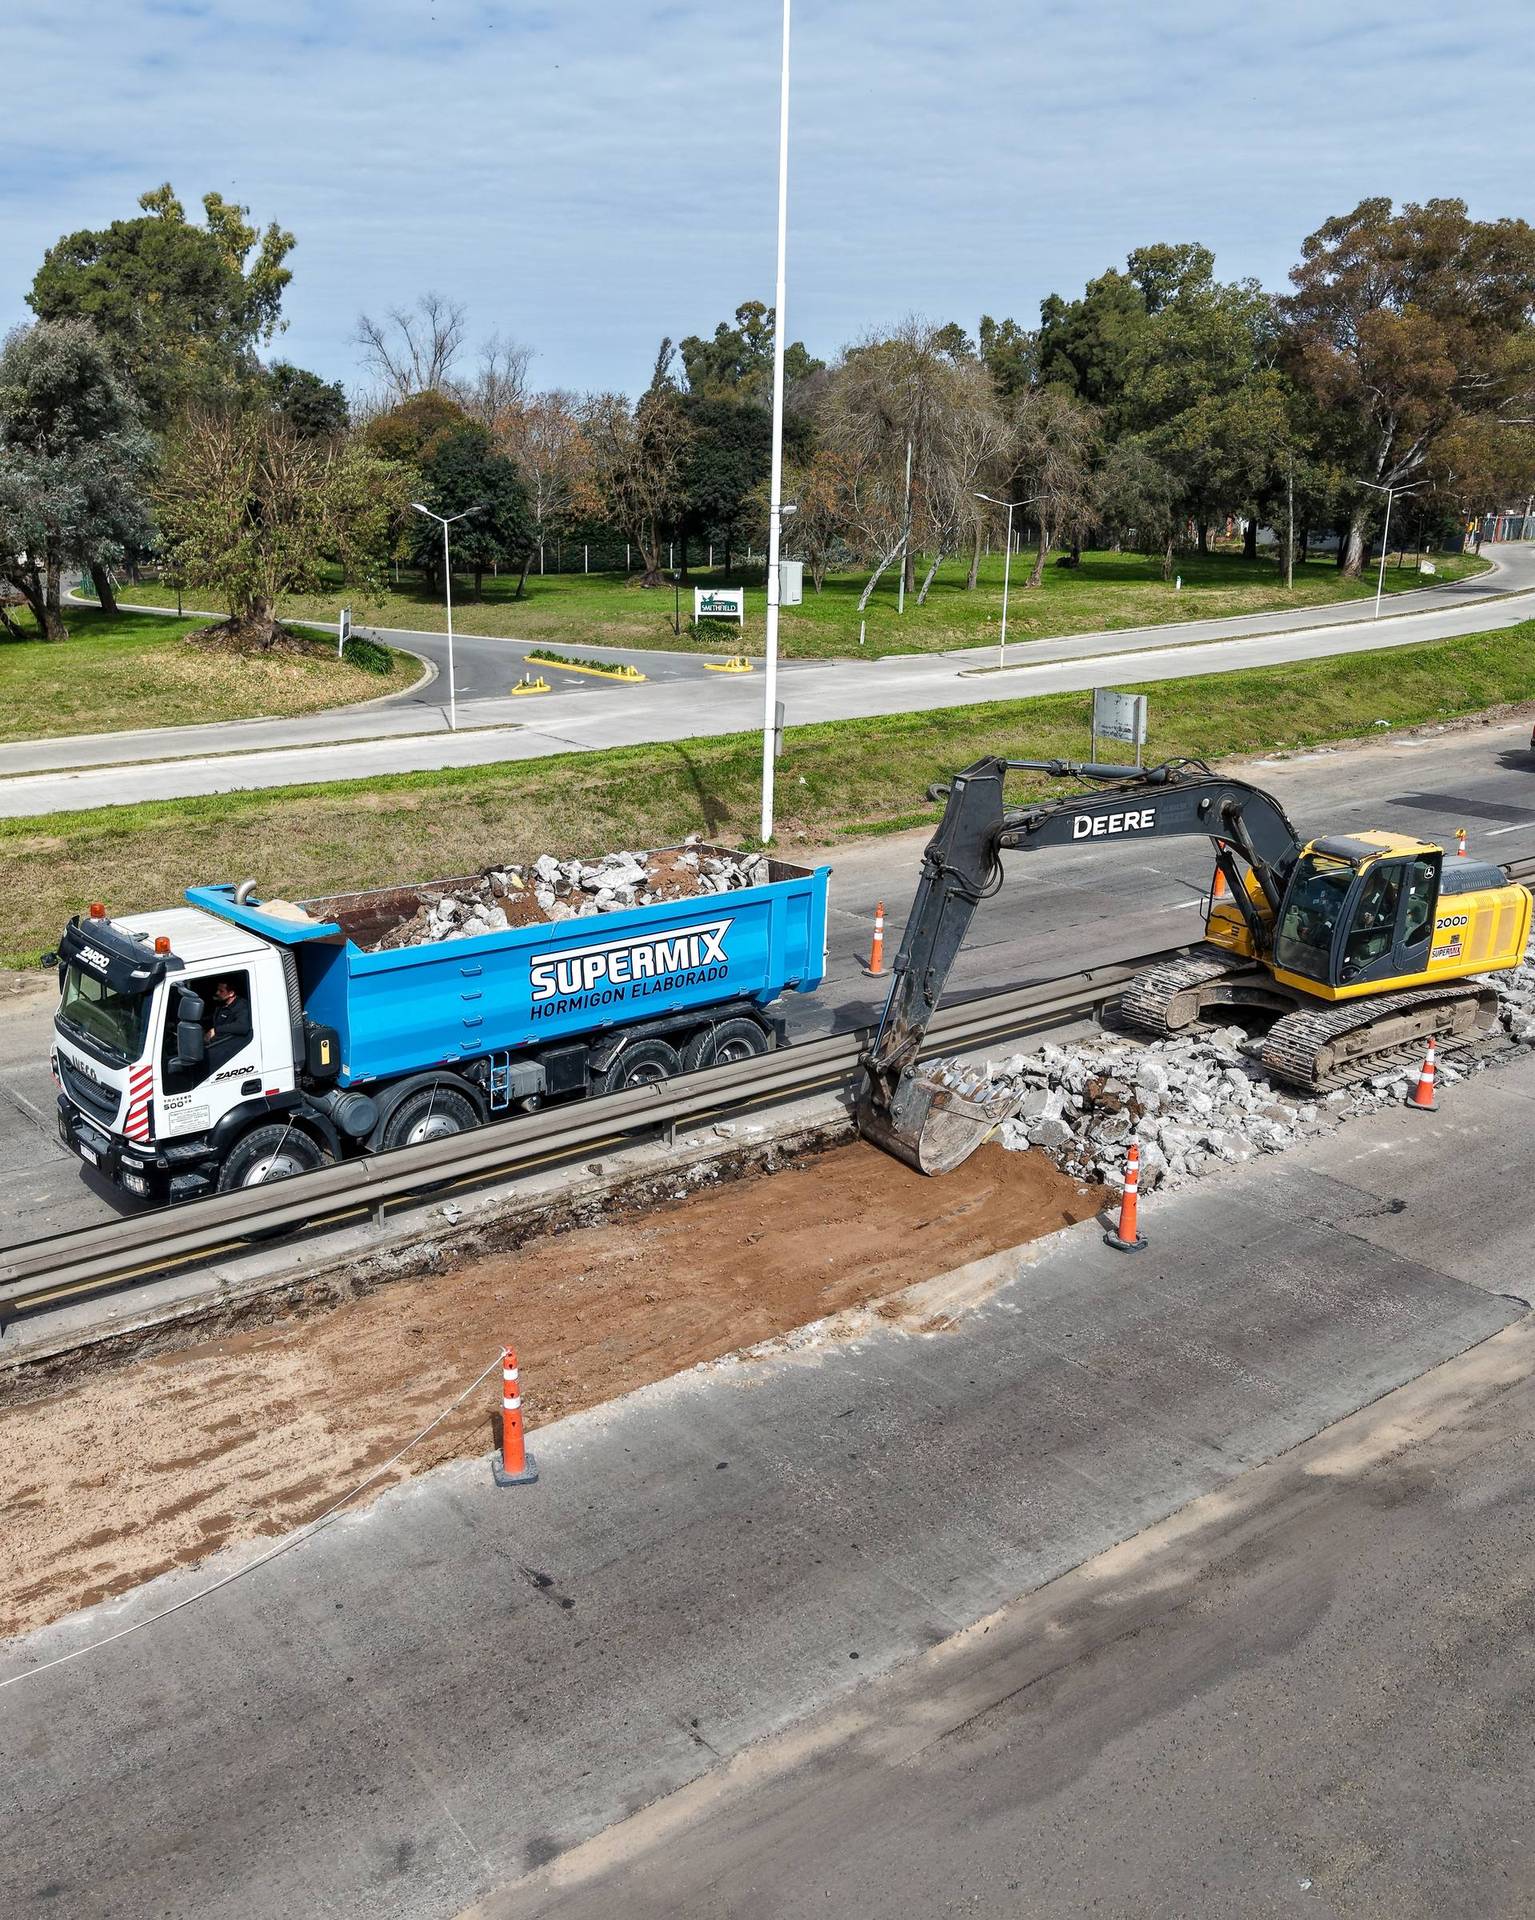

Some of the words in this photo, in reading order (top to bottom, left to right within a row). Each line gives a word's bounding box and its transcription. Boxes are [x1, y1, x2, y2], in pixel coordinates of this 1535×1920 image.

[1073, 808, 1156, 839] DEERE
[1436, 916, 1467, 929] 200D
[80, 945, 110, 968] ZARDO
[530, 917, 736, 1001] SUPERMIX
[530, 987, 624, 1020] HORMIGON
[631, 965, 728, 998] ELABORADO
[215, 1065, 255, 1081] ZARDO
[163, 1101, 184, 1111] 500
